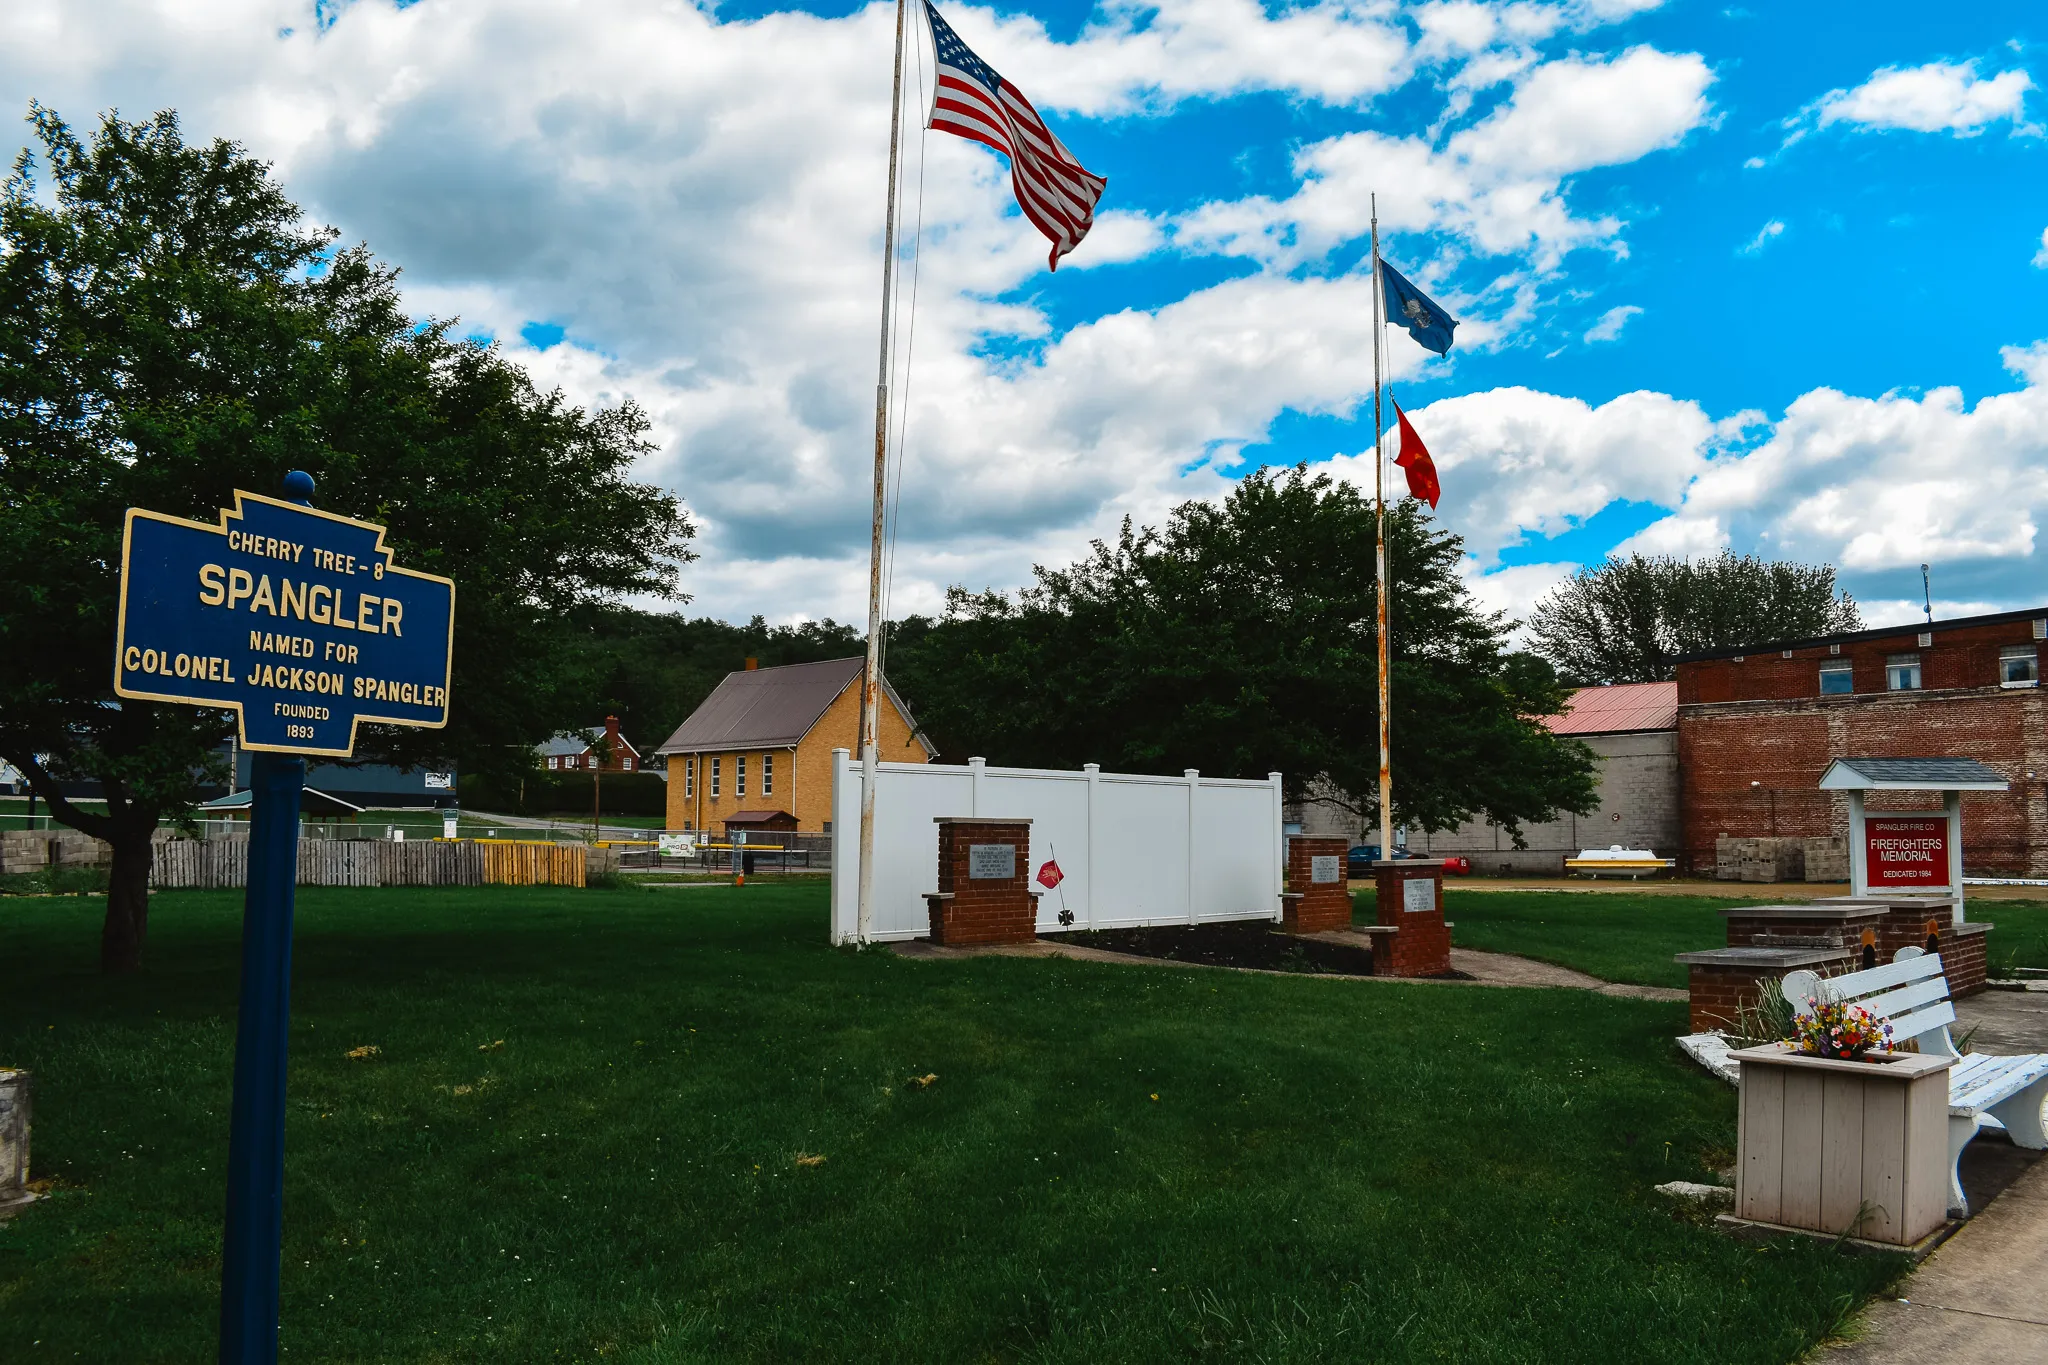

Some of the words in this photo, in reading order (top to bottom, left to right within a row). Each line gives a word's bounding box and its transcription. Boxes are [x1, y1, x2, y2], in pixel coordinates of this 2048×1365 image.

[228, 530, 304, 563] CHERRY
[199, 563, 403, 637] SPANGLER
[250, 630, 315, 659] NAMED
[325, 641, 359, 665] FOR
[124, 646, 236, 683] COLONEL
[247, 663, 344, 696] JACKSON
[353, 676, 445, 708] SPANGLER
[274, 702, 330, 721] FOUNDED
[286, 724, 315, 739] 1893
[1870, 838, 1943, 850] FIREFIGHTERS
[1880, 850, 1933, 862] MEMORIAL
